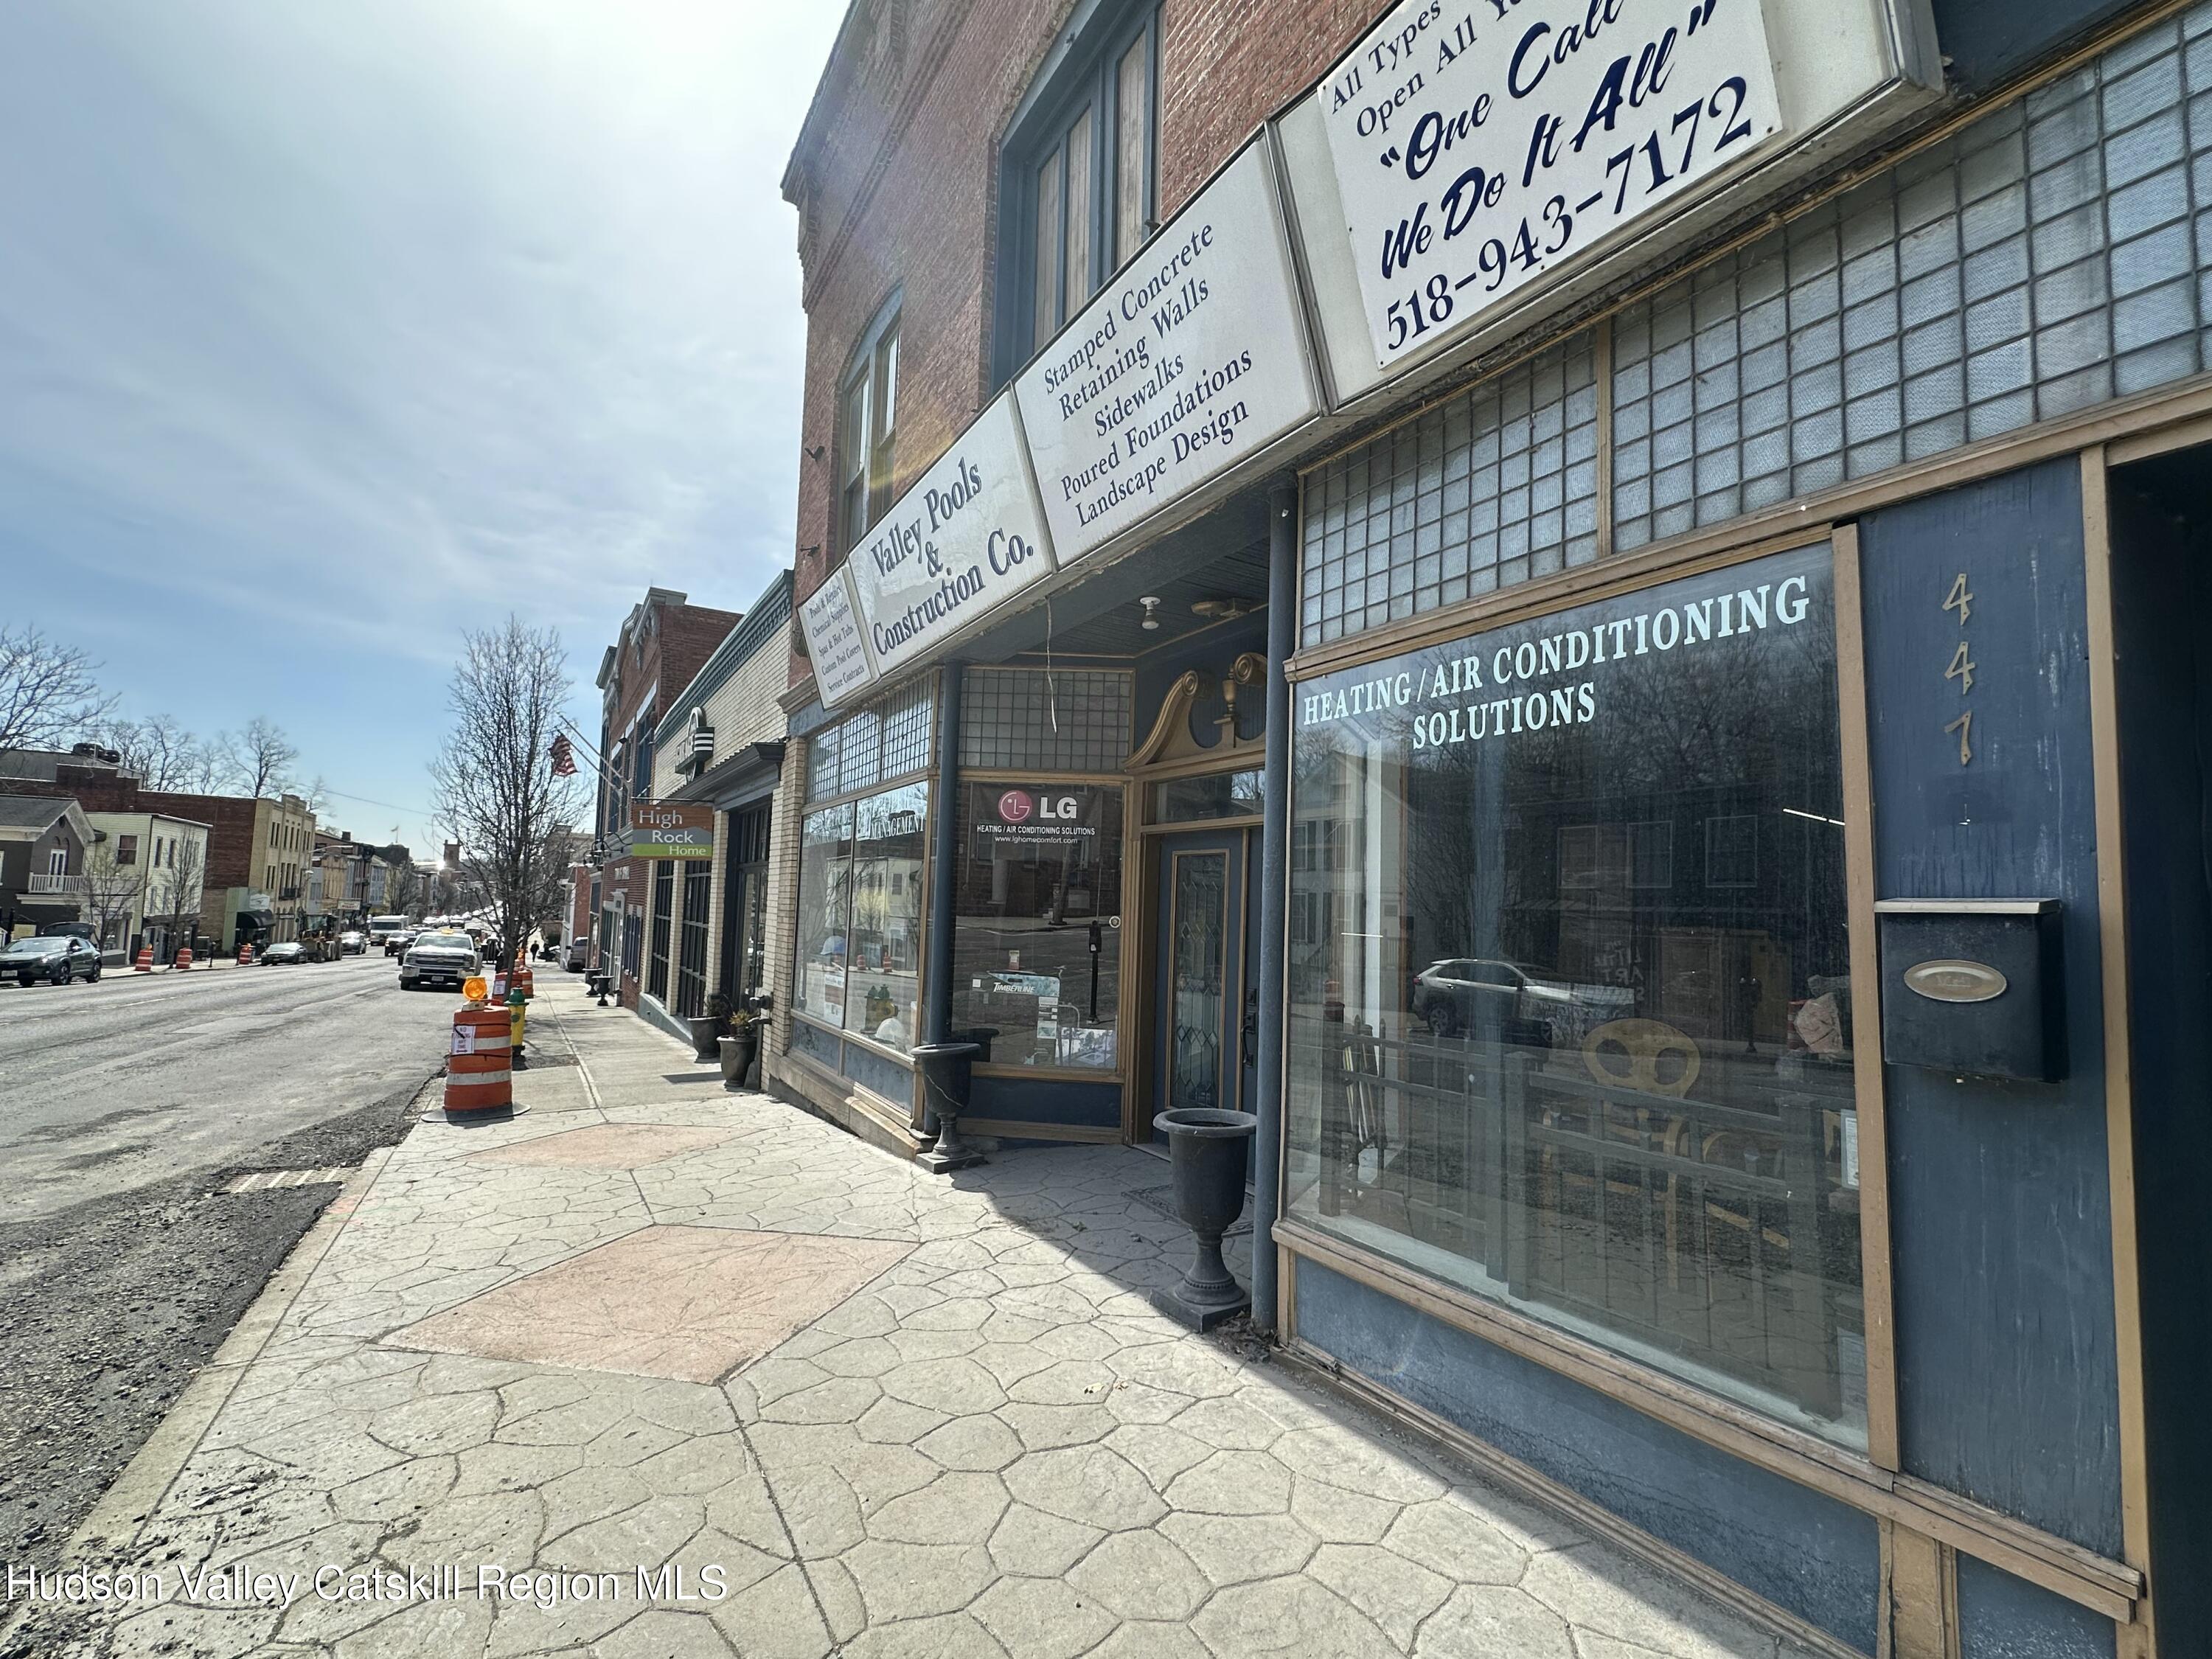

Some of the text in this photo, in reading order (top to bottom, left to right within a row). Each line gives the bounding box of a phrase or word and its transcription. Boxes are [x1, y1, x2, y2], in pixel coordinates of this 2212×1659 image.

[1331, 1, 1441, 114] All Types
[1357, 73, 1425, 137] Open
[1437, 13, 1478, 74] All
[1381, 201, 1434, 279] We
[1440, 167, 1508, 240] Do
[1523, 113, 1565, 187] It
[1387, 76, 1752, 350] 518-943-7172
[1044, 224, 1214, 394] Stamped Concrete
[1059, 279, 1209, 421] Retaining Walls
[1060, 349, 1252, 501] Poured Foundations
[1094, 354, 1183, 437] Sidewalks
[1075, 401, 1249, 526] Landscape Design
[870, 456, 982, 577] Valley Pools
[873, 527, 1034, 655] Construction Co.
[925, 541, 943, 577] &
[812, 602, 849, 638] Chemical Supplies
[818, 624, 854, 659] Spas & Hot Tubs
[1493, 576, 1809, 684] CONDITIONING
[821, 644, 861, 675] Custom Pool Covers
[827, 664, 865, 693] Service Contracts
[1413, 682, 1596, 750] SOLUTIONS
[639, 807, 683, 829] High
[652, 830, 694, 844] Rock
[872, 814, 925, 838] MANAGEMENT
[977, 824, 1002, 833] HEATING
[1006, 825, 1017, 834] AIR
[1018, 826, 1060, 835] CONDITIONING
[1061, 827, 1096, 835] SOLUTIONS
[995, 835, 1078, 844] www.lghomecomfort.com
[1040, 796, 1077, 819] LG
[669, 846, 707, 855] Home
